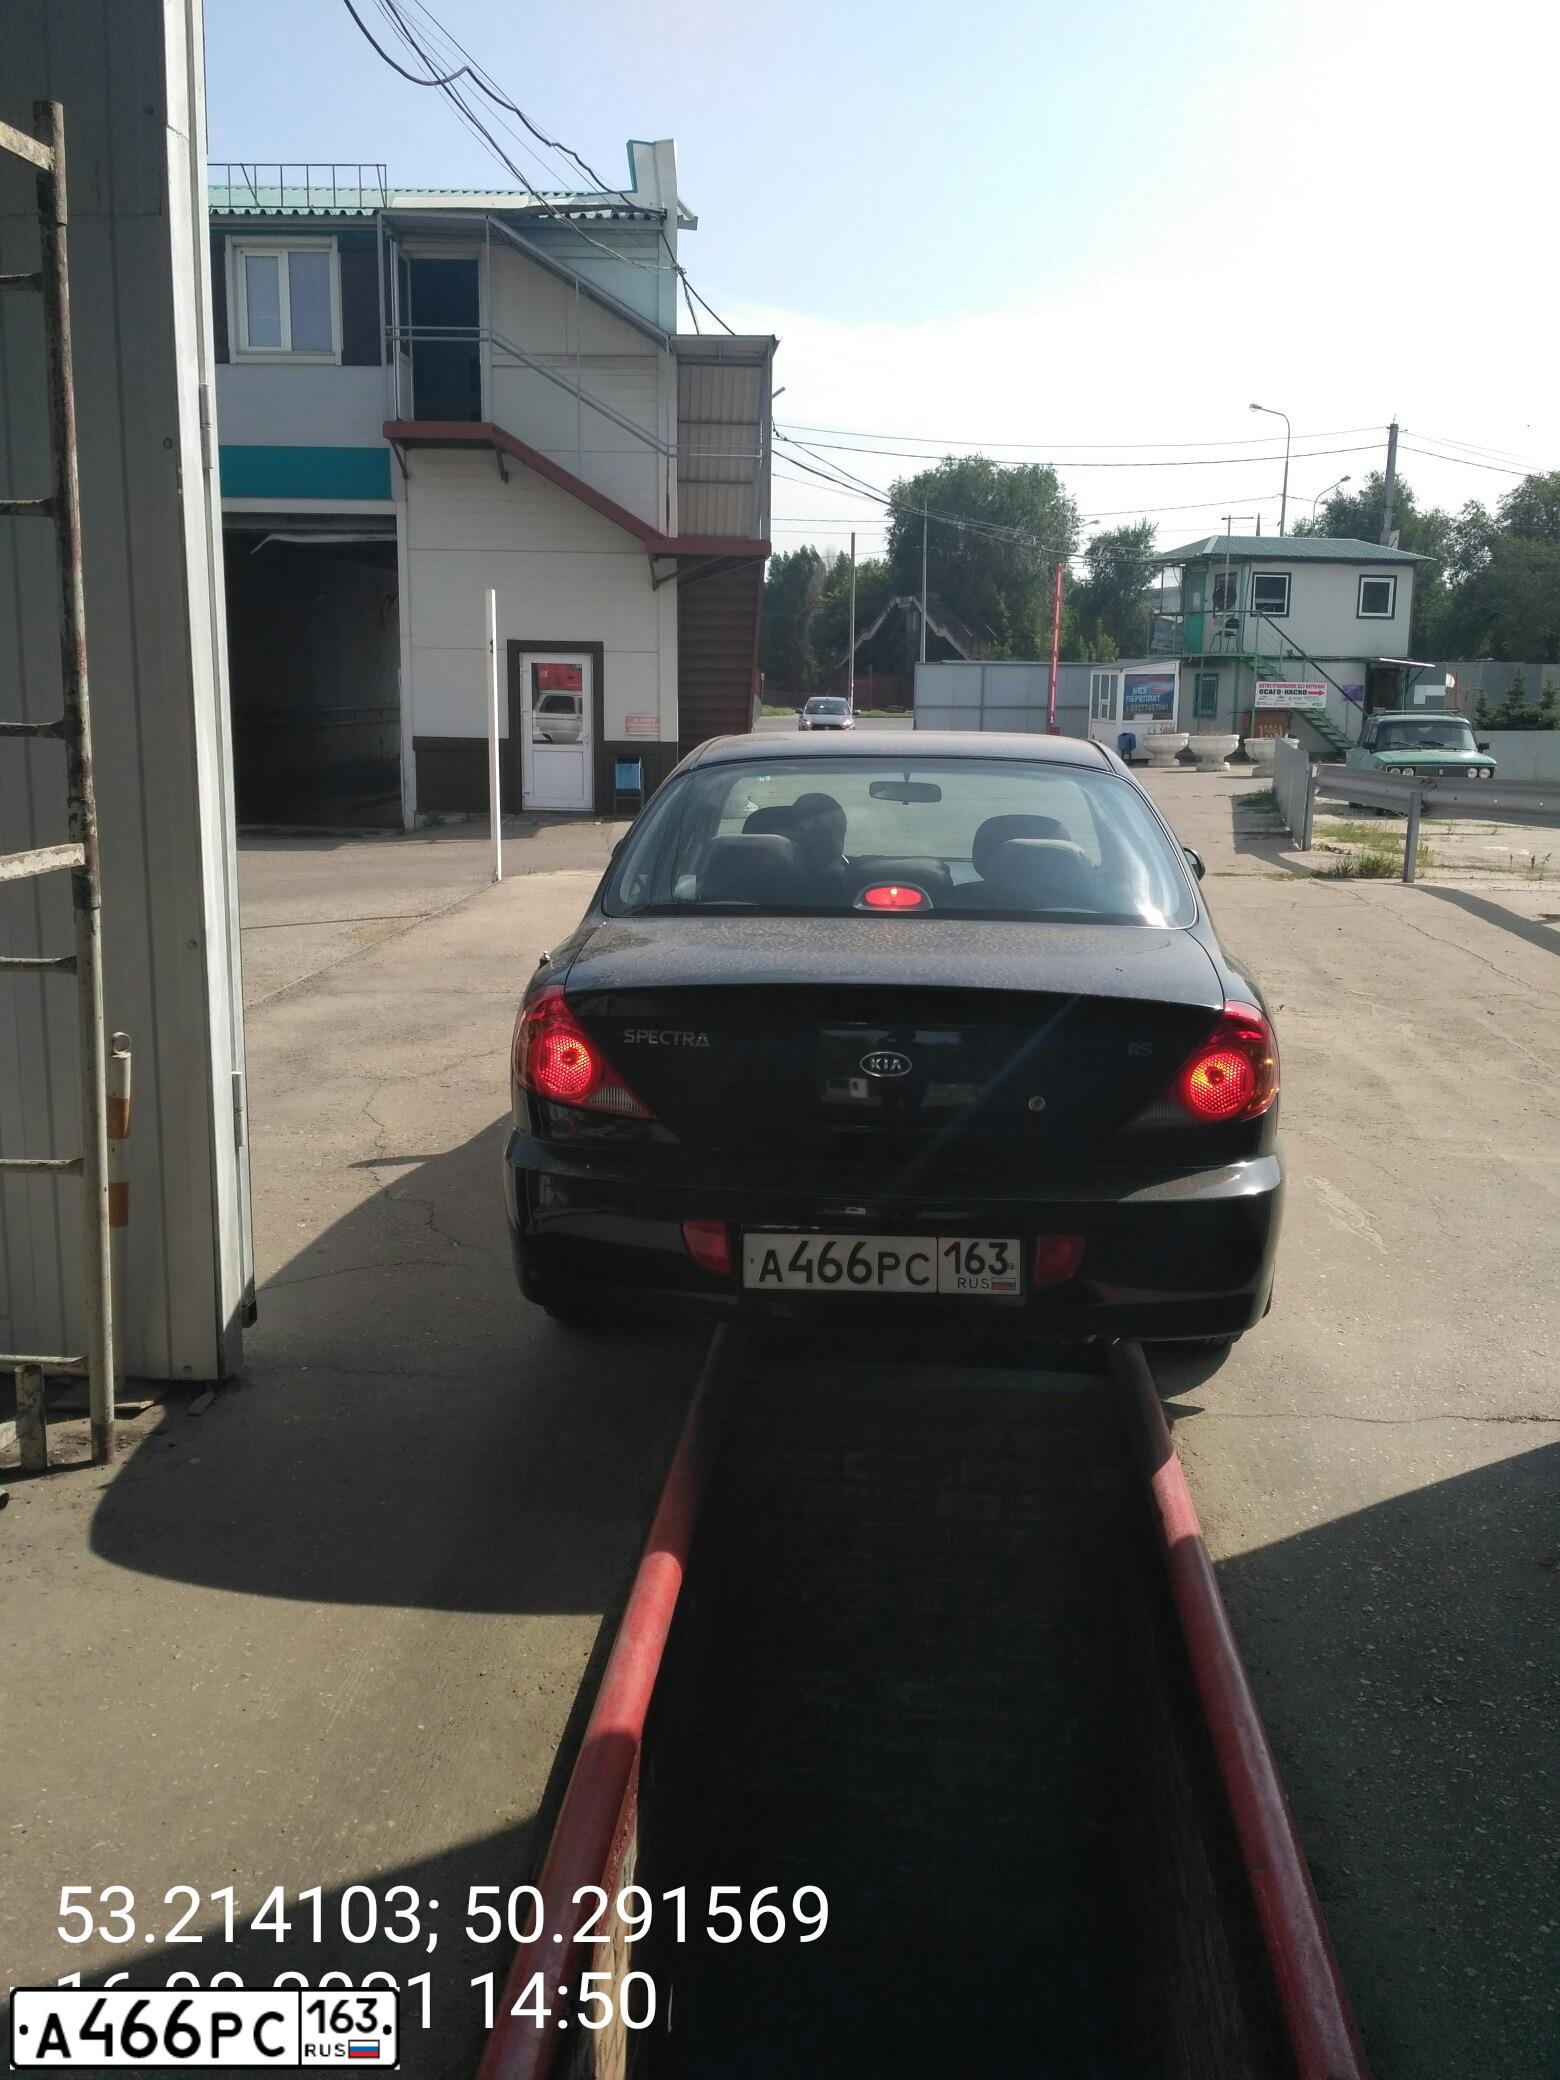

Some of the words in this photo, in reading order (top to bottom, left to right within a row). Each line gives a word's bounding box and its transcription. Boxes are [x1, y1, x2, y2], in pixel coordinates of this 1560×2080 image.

[1132, 686, 1147, 695] БЕЗ
[623, 1028, 711, 1048] SPECTRA
[871, 1057, 902, 1071] KIA
[943, 1241, 1009, 1276] 163
[957, 1277, 991, 1290] RUS
